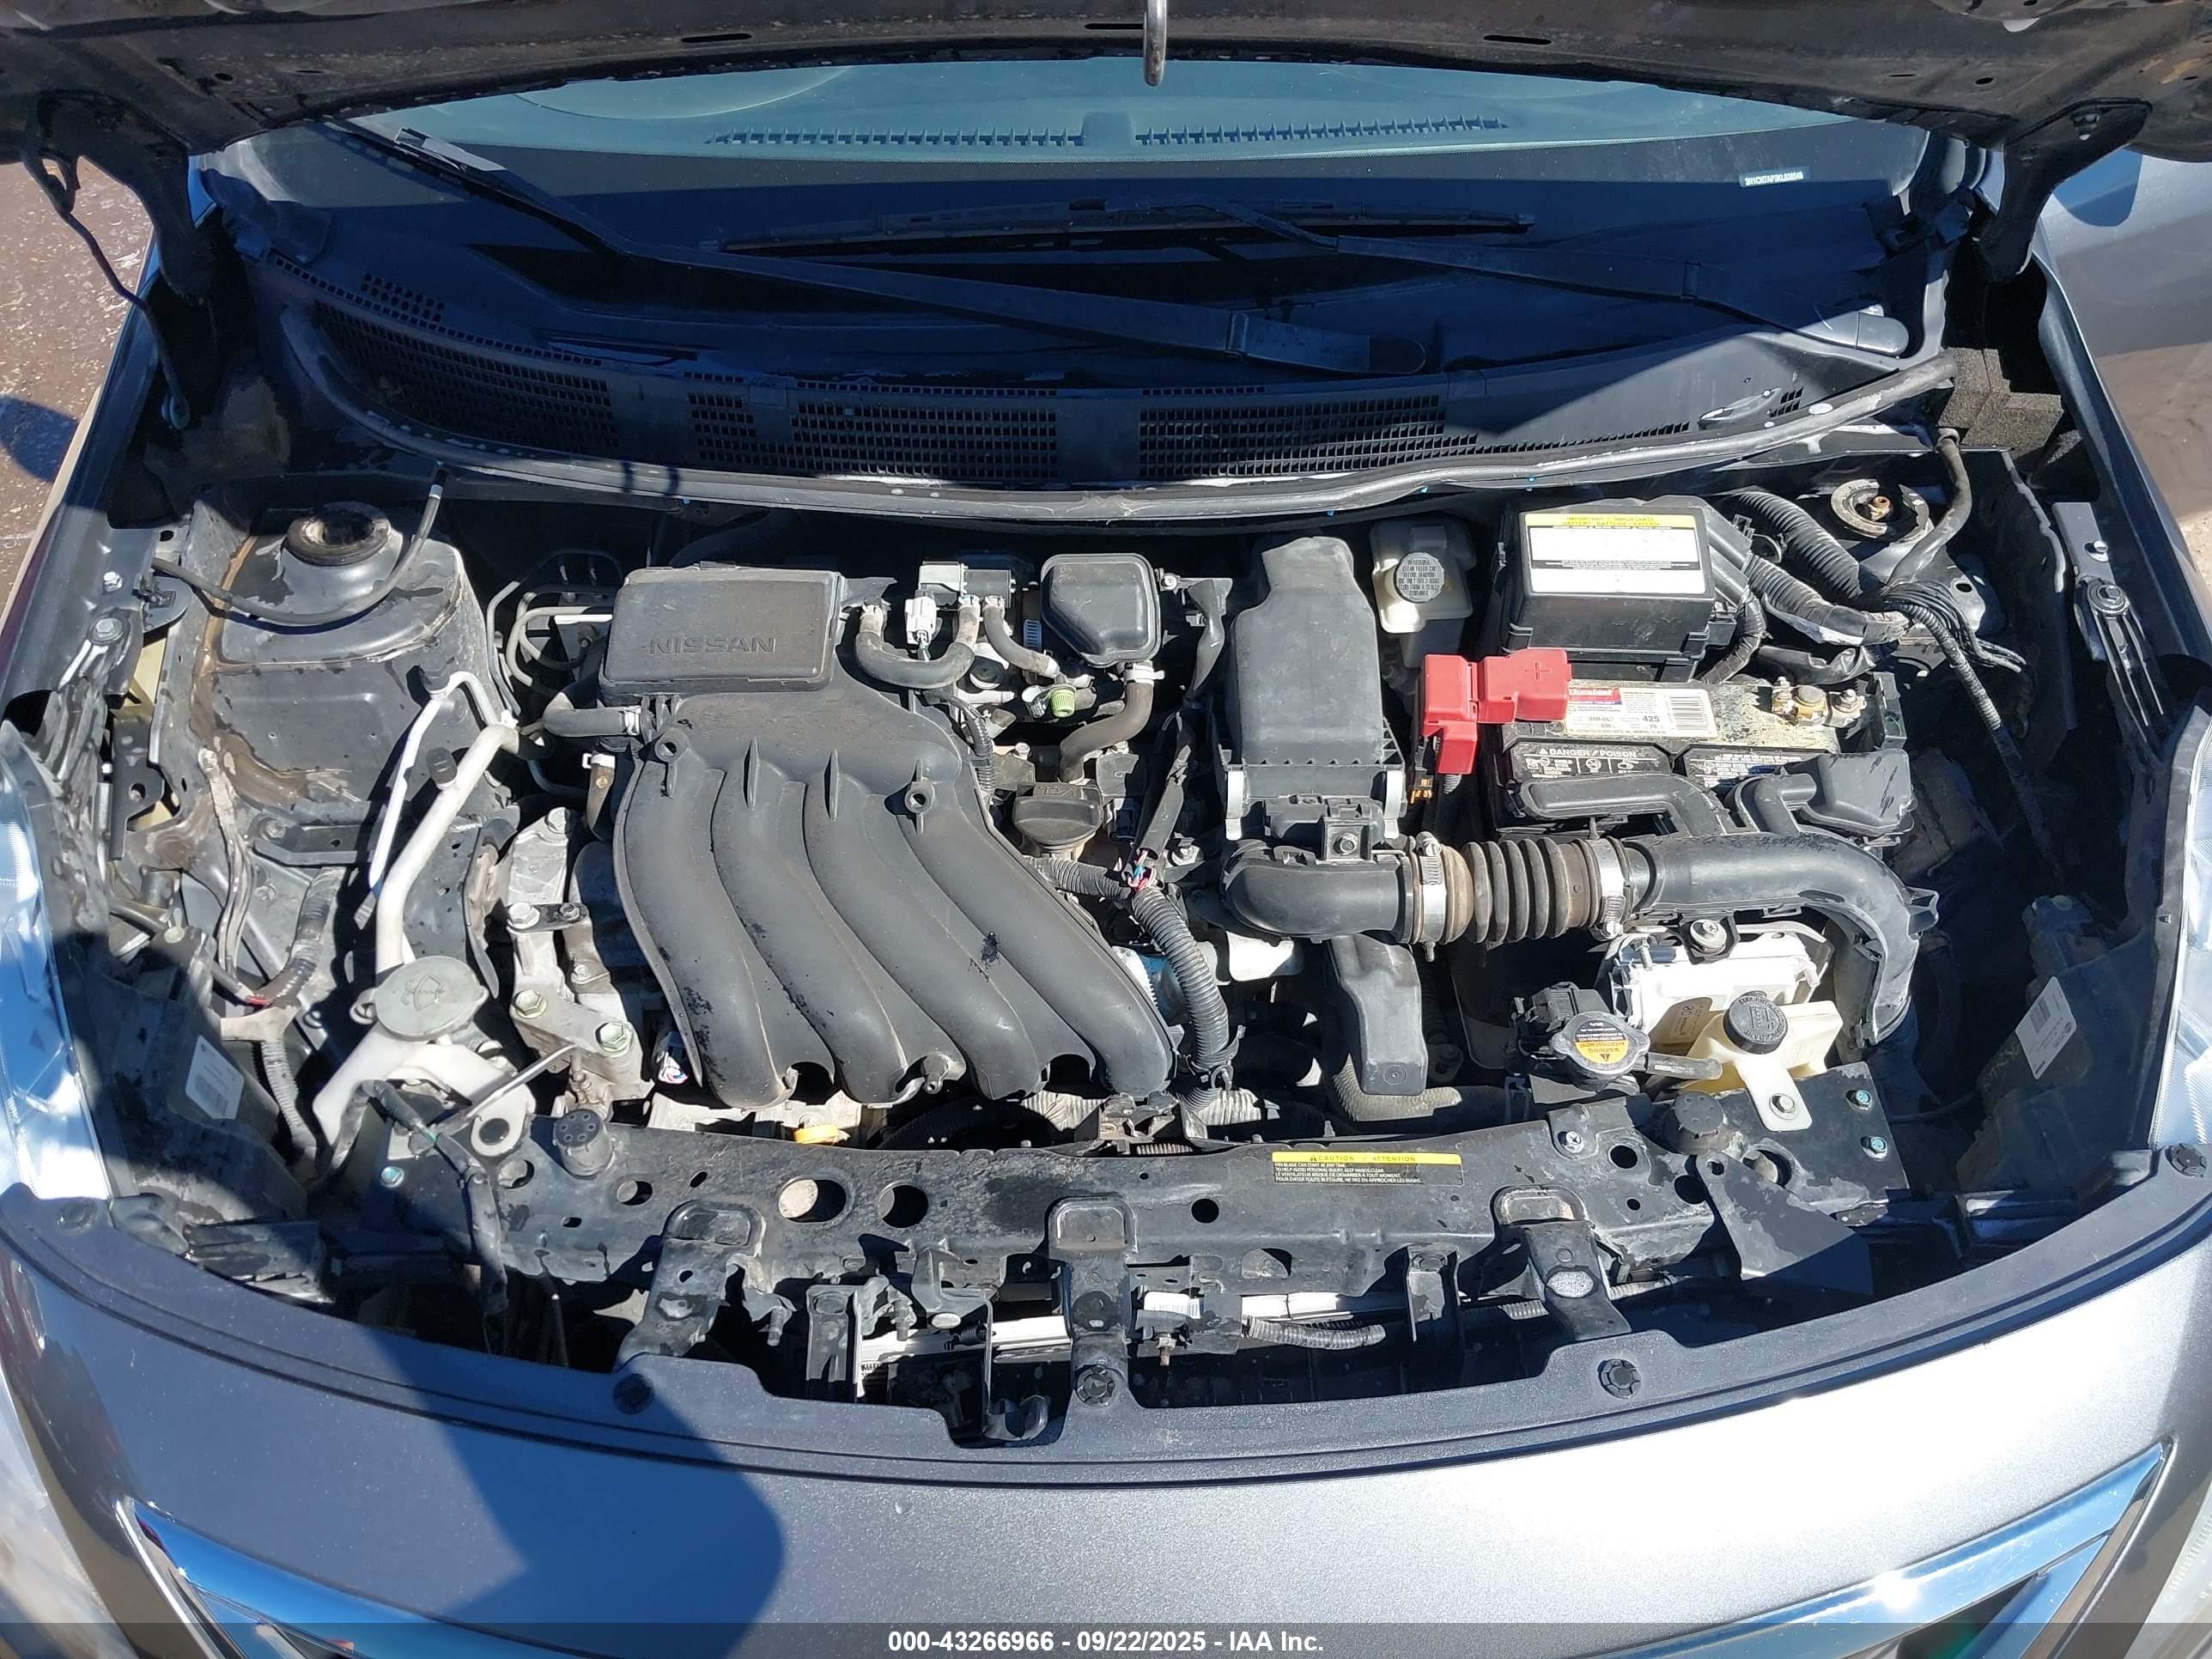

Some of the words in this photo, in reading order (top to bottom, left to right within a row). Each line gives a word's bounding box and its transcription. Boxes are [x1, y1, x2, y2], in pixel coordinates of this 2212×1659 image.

[649, 636, 776, 653] NISSAN
[1549, 748, 1589, 757] DANGER
[1601, 750, 1637, 758] POISON
